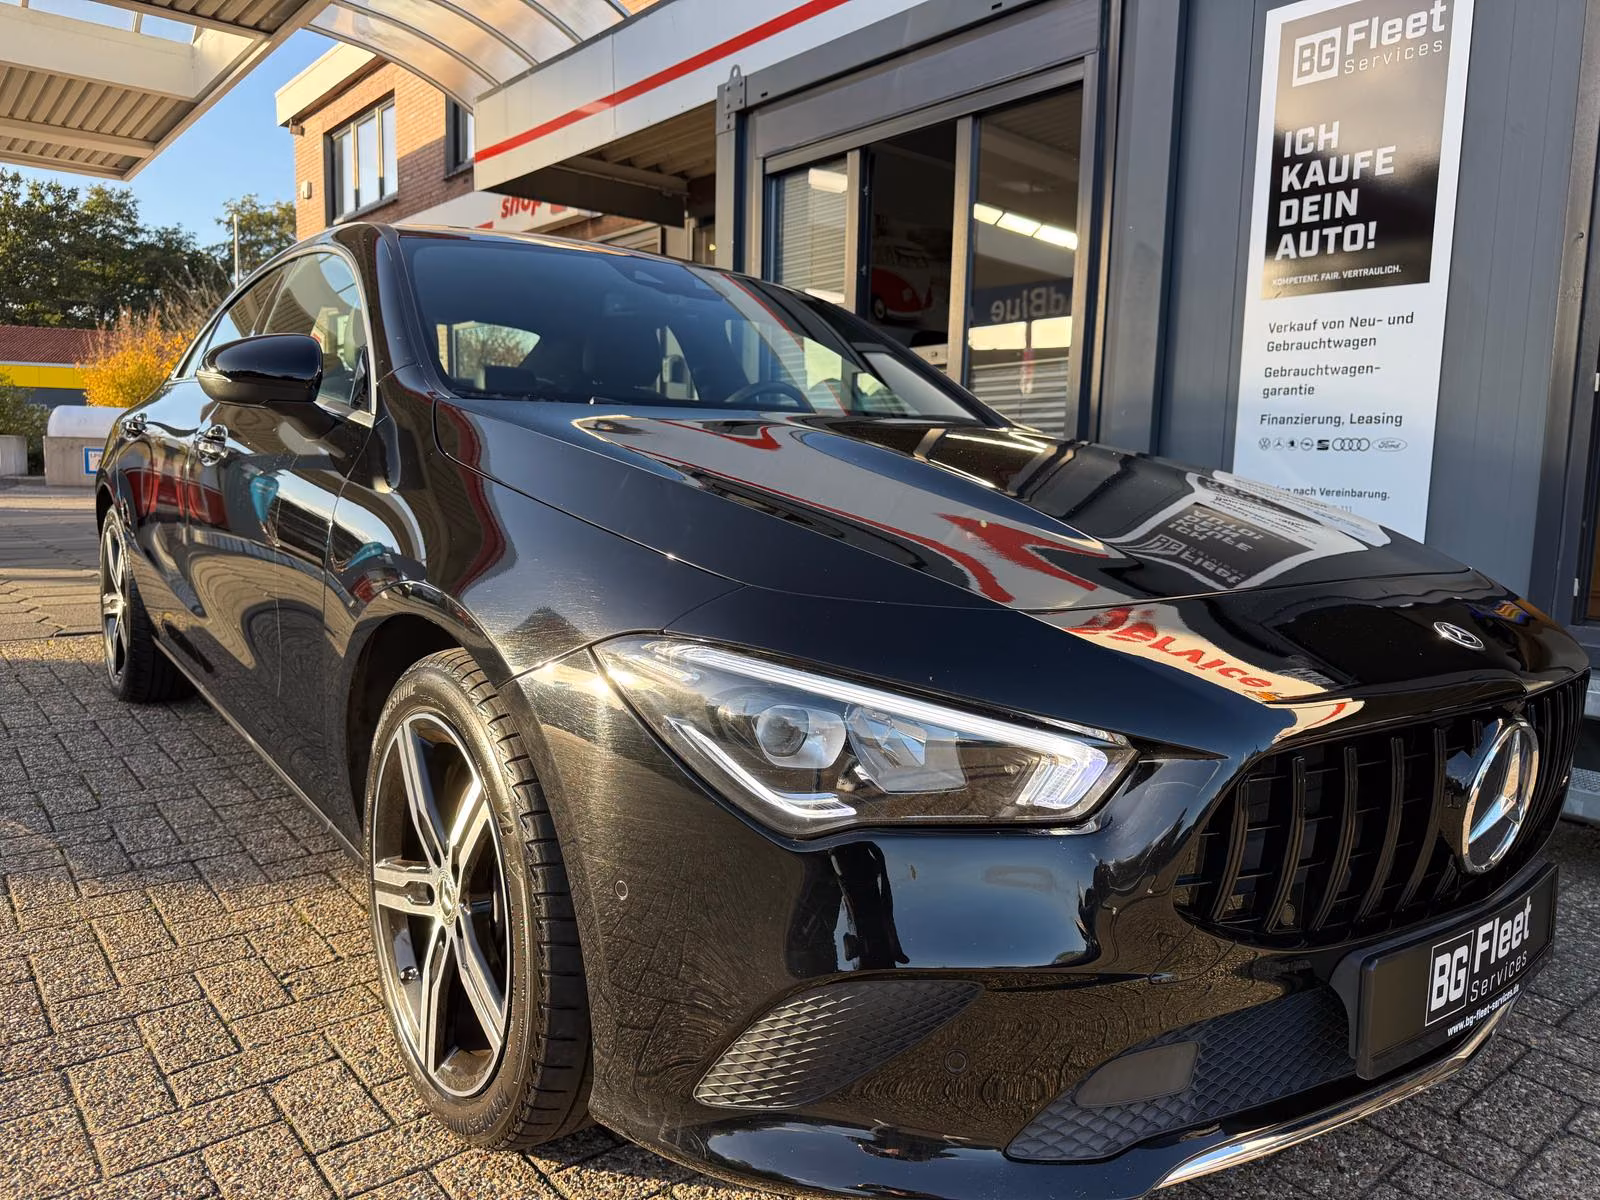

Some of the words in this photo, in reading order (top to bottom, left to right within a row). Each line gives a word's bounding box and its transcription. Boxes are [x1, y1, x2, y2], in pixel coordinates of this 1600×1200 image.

[1296, 34, 1338, 80] BG
[1346, 0, 1447, 55] Fleet
[1344, 39, 1443, 75] Services
[1283, 120, 1340, 158] ICH
[1281, 145, 1396, 193] KAUFE
[1278, 188, 1359, 227] DEIN
[1274, 221, 1377, 261] AUTO!
[1272, 273, 1319, 286] KOMPETENT.
[1320, 271, 1341, 281] FAIR.
[1342, 264, 1401, 279] VERTRAULICH.
[1268, 319, 1318, 334] Verkauf
[1321, 319, 1345, 330] von
[1349, 316, 1383, 328] Neu-
[1387, 312, 1414, 325] und
[1266, 336, 1377, 352] Gebrauchtwagen
[1264, 363, 1381, 379] Gebrauchtwagen-
[1262, 384, 1315, 399] garantie
[1259, 413, 1345, 427] Finanzierung,
[1350, 413, 1403, 427] Leasing
[1293, 487, 1316, 496] nach
[1319, 487, 1391, 500] Vereinbarung.
[1430, 944, 1469, 1012] BG
[1474, 896, 1532, 973] Fleet
[1470, 950, 1527, 1002] Services
[1447, 984, 1520, 1037] www.bg-fleet-services.de
